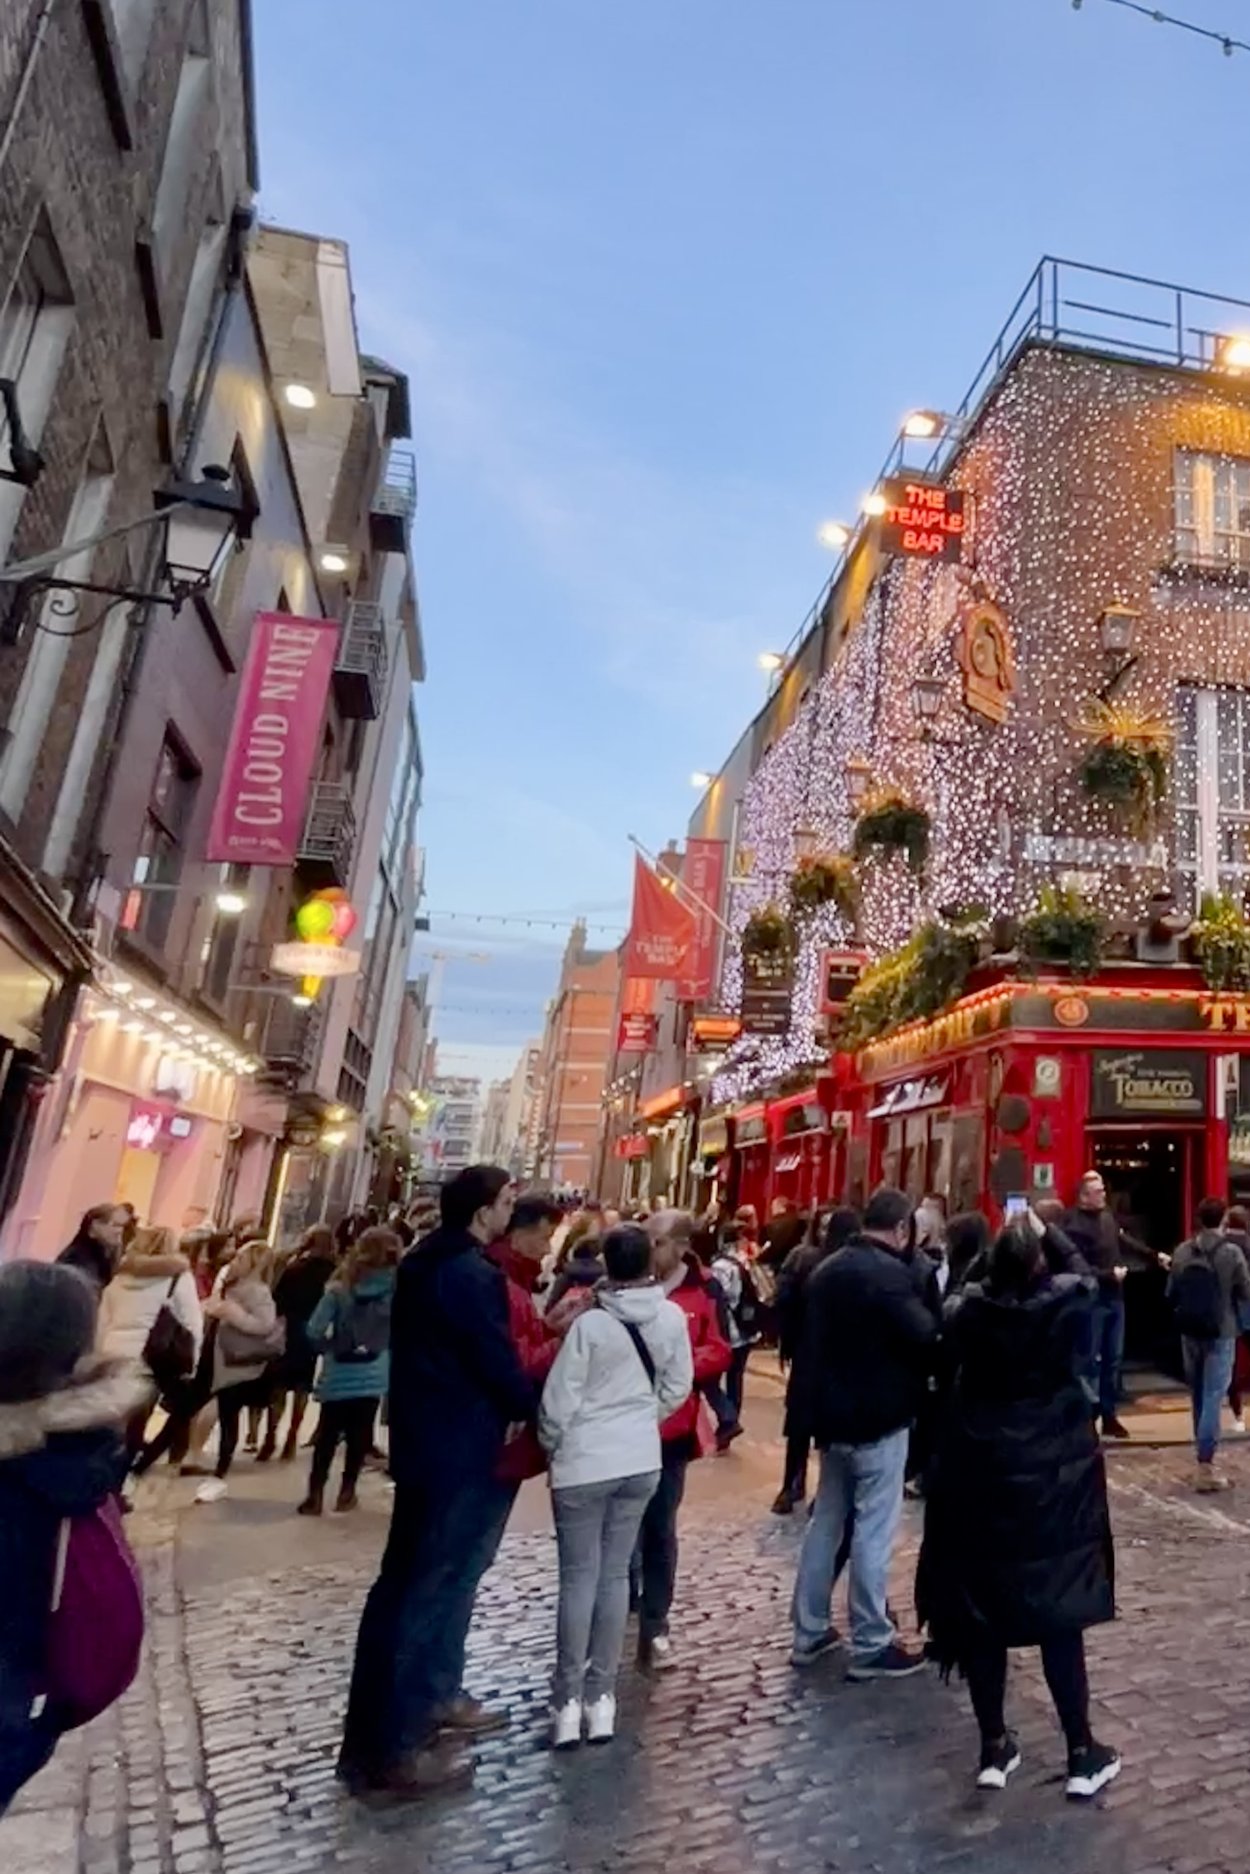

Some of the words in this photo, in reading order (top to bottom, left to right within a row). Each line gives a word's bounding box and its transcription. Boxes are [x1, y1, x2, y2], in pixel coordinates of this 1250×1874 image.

[905, 484, 945, 509] THE
[887, 505, 966, 532] TEMPLE
[903, 531, 944, 552] BAR
[259, 624, 321, 702] NINE
[235, 713, 289, 826] CLOUD
[1108, 1072, 1194, 1105] TOBACCO
